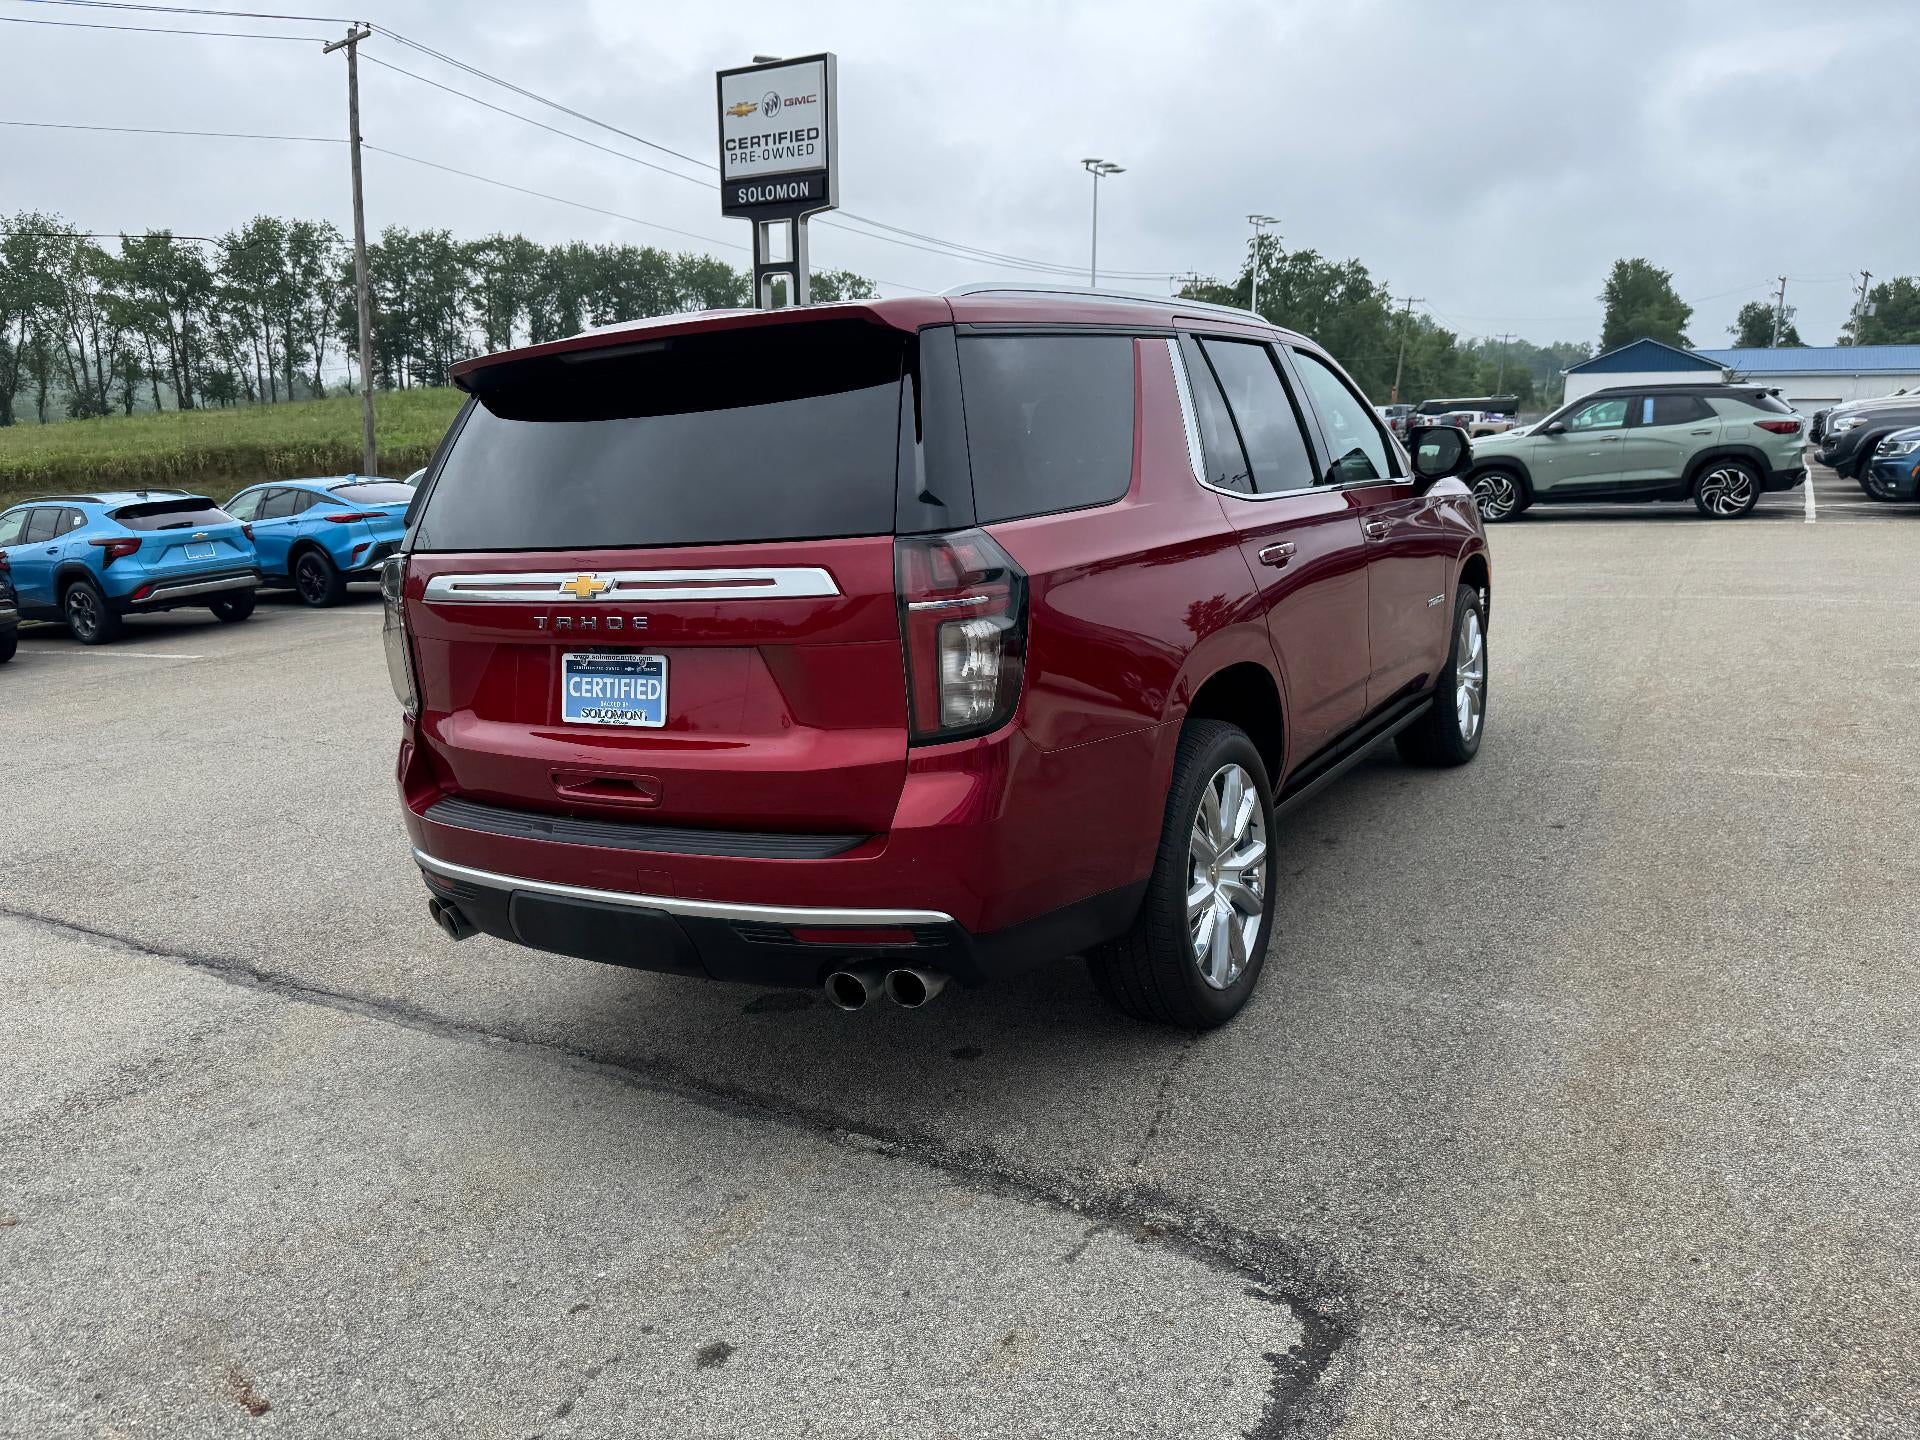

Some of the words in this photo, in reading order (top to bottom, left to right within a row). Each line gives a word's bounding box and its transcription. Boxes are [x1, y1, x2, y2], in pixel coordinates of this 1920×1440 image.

[783, 94, 817, 107] GMC
[725, 127, 820, 151] CERTIFIED
[730, 143, 815, 165] PRE-OWNED
[738, 181, 809, 204] SOLOMON
[533, 616, 648, 630] TAHOE
[569, 676, 661, 700] CERTIFIED
[581, 707, 643, 721] SOLOMON
